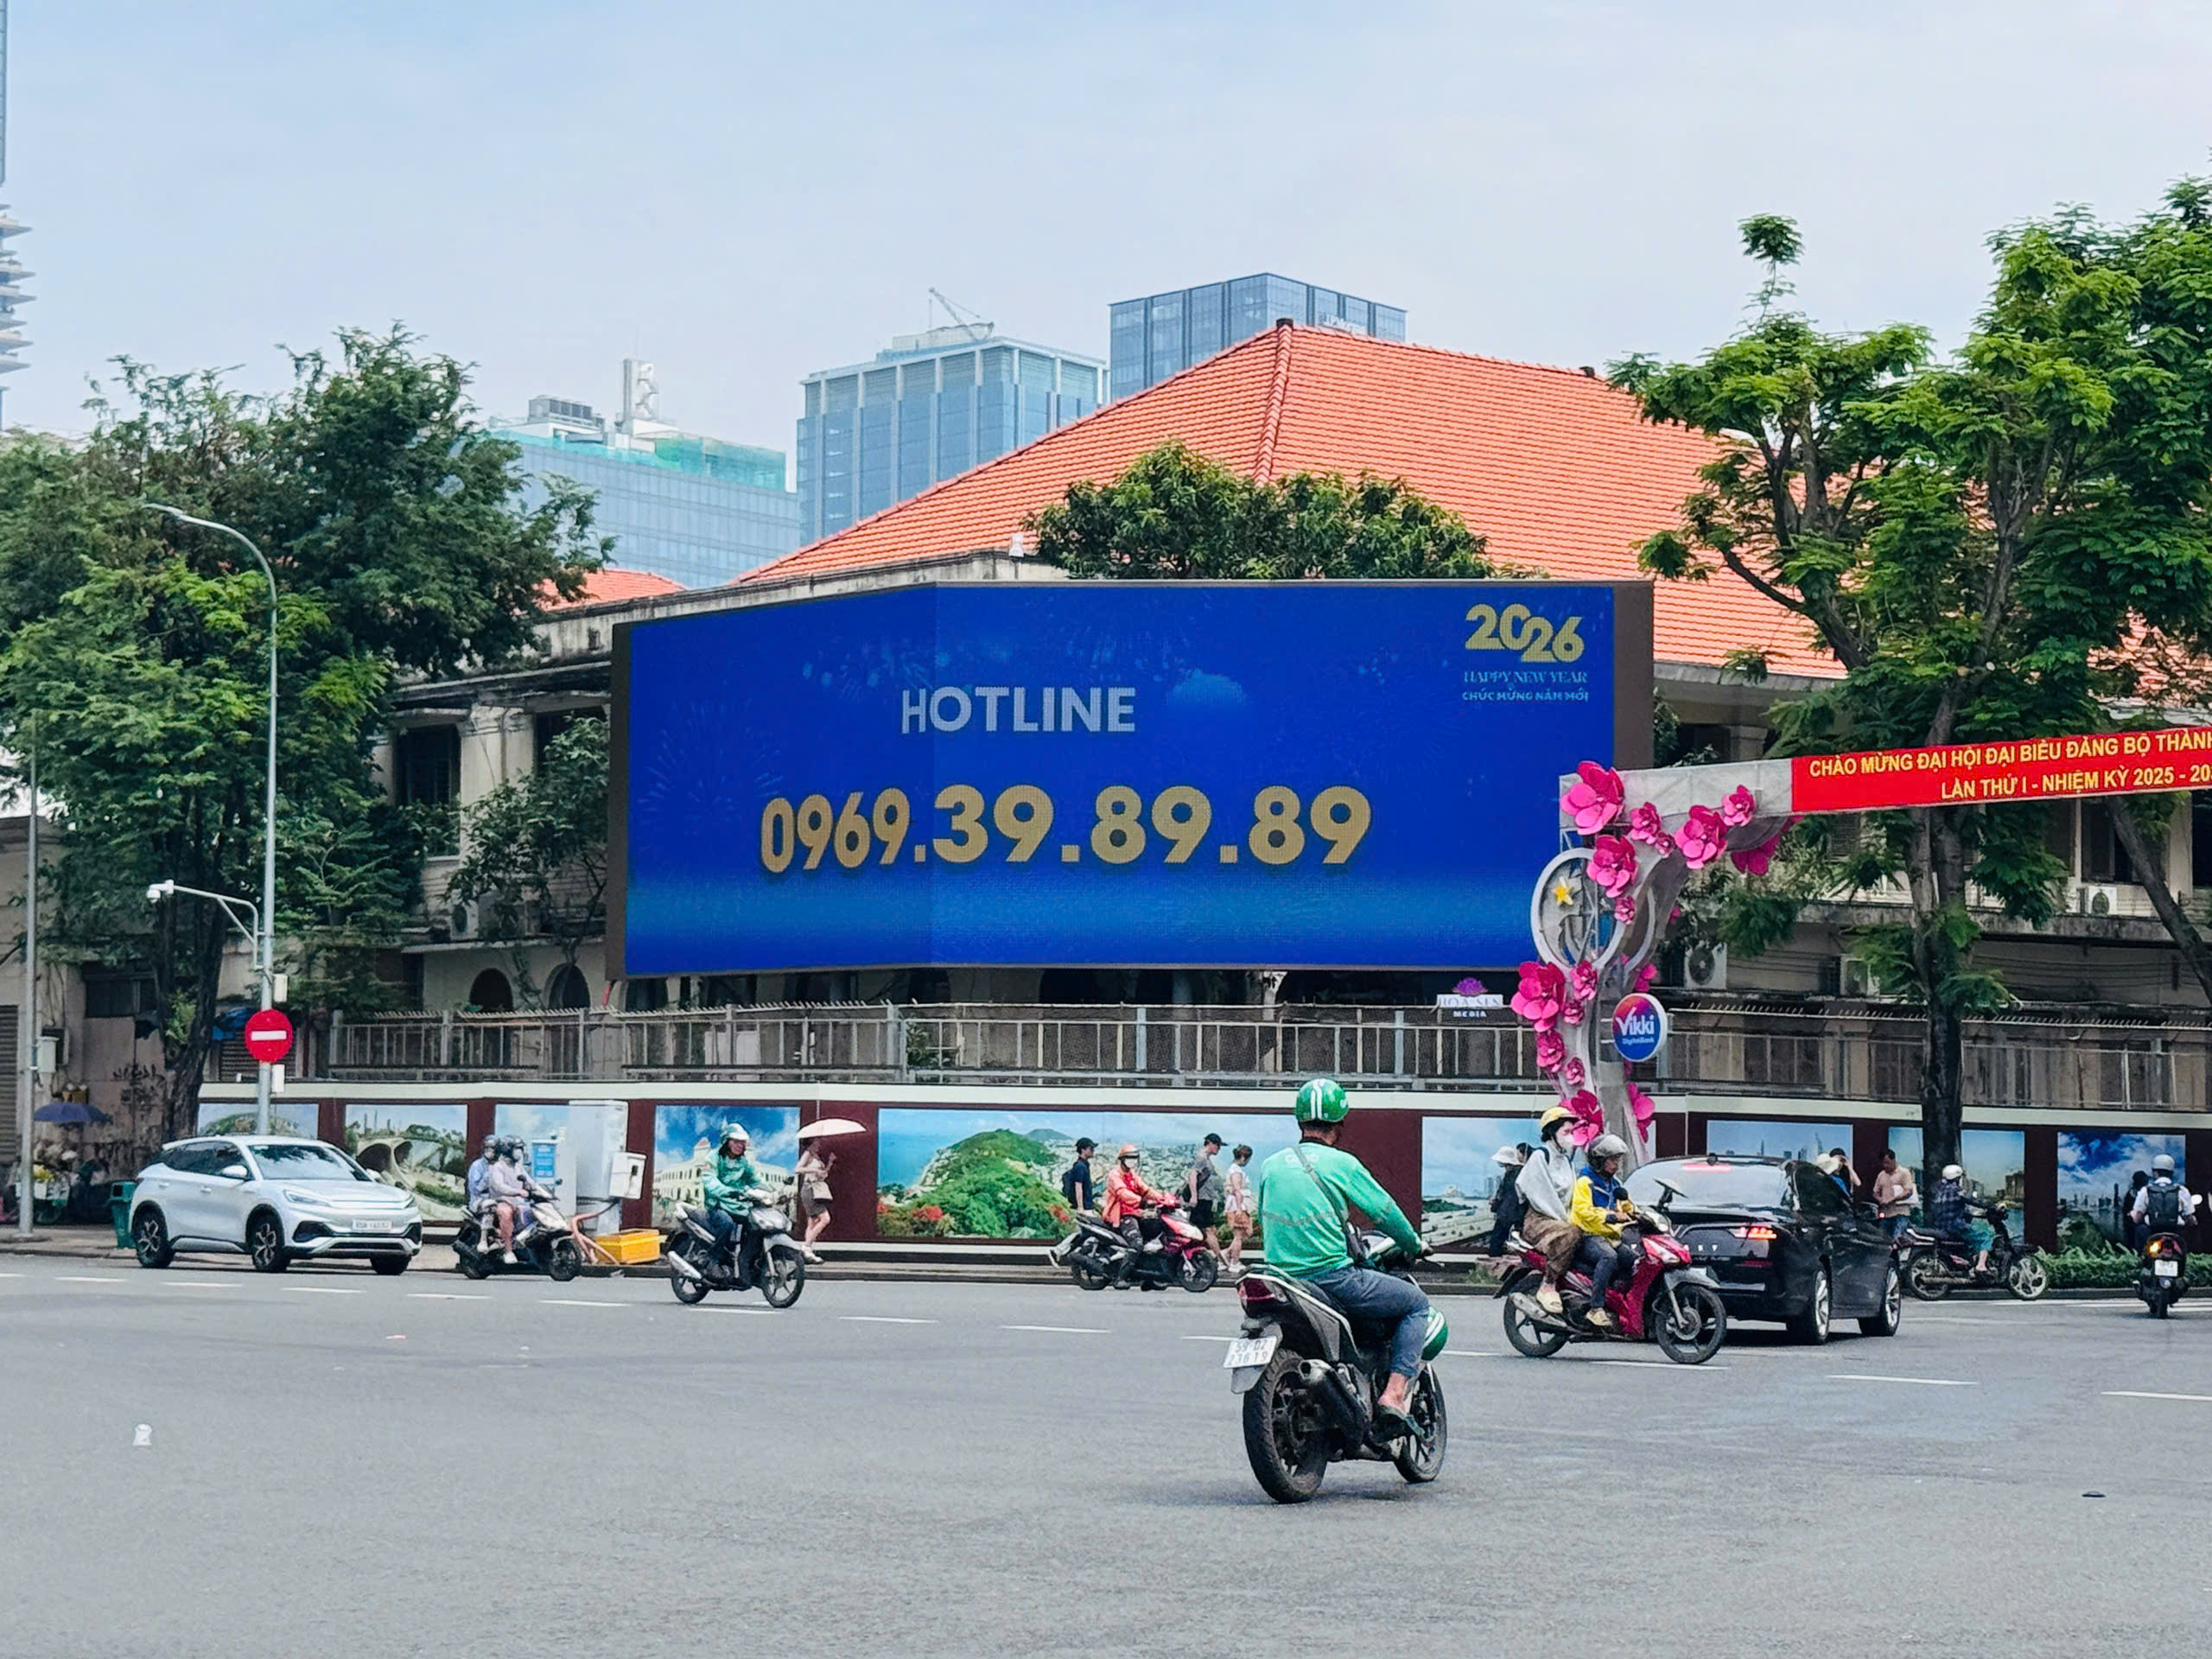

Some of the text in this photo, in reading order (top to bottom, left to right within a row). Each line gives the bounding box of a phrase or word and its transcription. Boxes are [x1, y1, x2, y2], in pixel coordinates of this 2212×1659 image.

[1465, 603, 1585, 664] 2026
[1462, 687, 1494, 702] CHÚC
[1464, 671, 1587, 683] HAPPY NEW YEAR
[901, 686, 1136, 734] HOTLINE
[1809, 754, 1857, 777] CHÀO
[1860, 752, 1914, 774] MỪNG
[1916, 750, 1946, 772] ĐẠI
[1951, 747, 1981, 770] HỘI
[1985, 745, 2015, 767] ĐẠI
[2019, 739, 2062, 762] BIỂU
[2066, 735, 2119, 759] ĐẢNG
[2124, 733, 2151, 758] BỘ
[1941, 777, 1976, 799] LẦN
[1980, 772, 2018, 797] THỨ
[2022, 776, 2027, 794] I
[2042, 768, 2099, 794] NHIỆM
[2103, 764, 2130, 788] KỲ
[2133, 766, 2175, 786] 2025
[2190, 764, 2212, 783] 20
[760, 784, 1372, 874] 0969.39.89.89
[1616, 1007, 1655, 1036] Vikki
